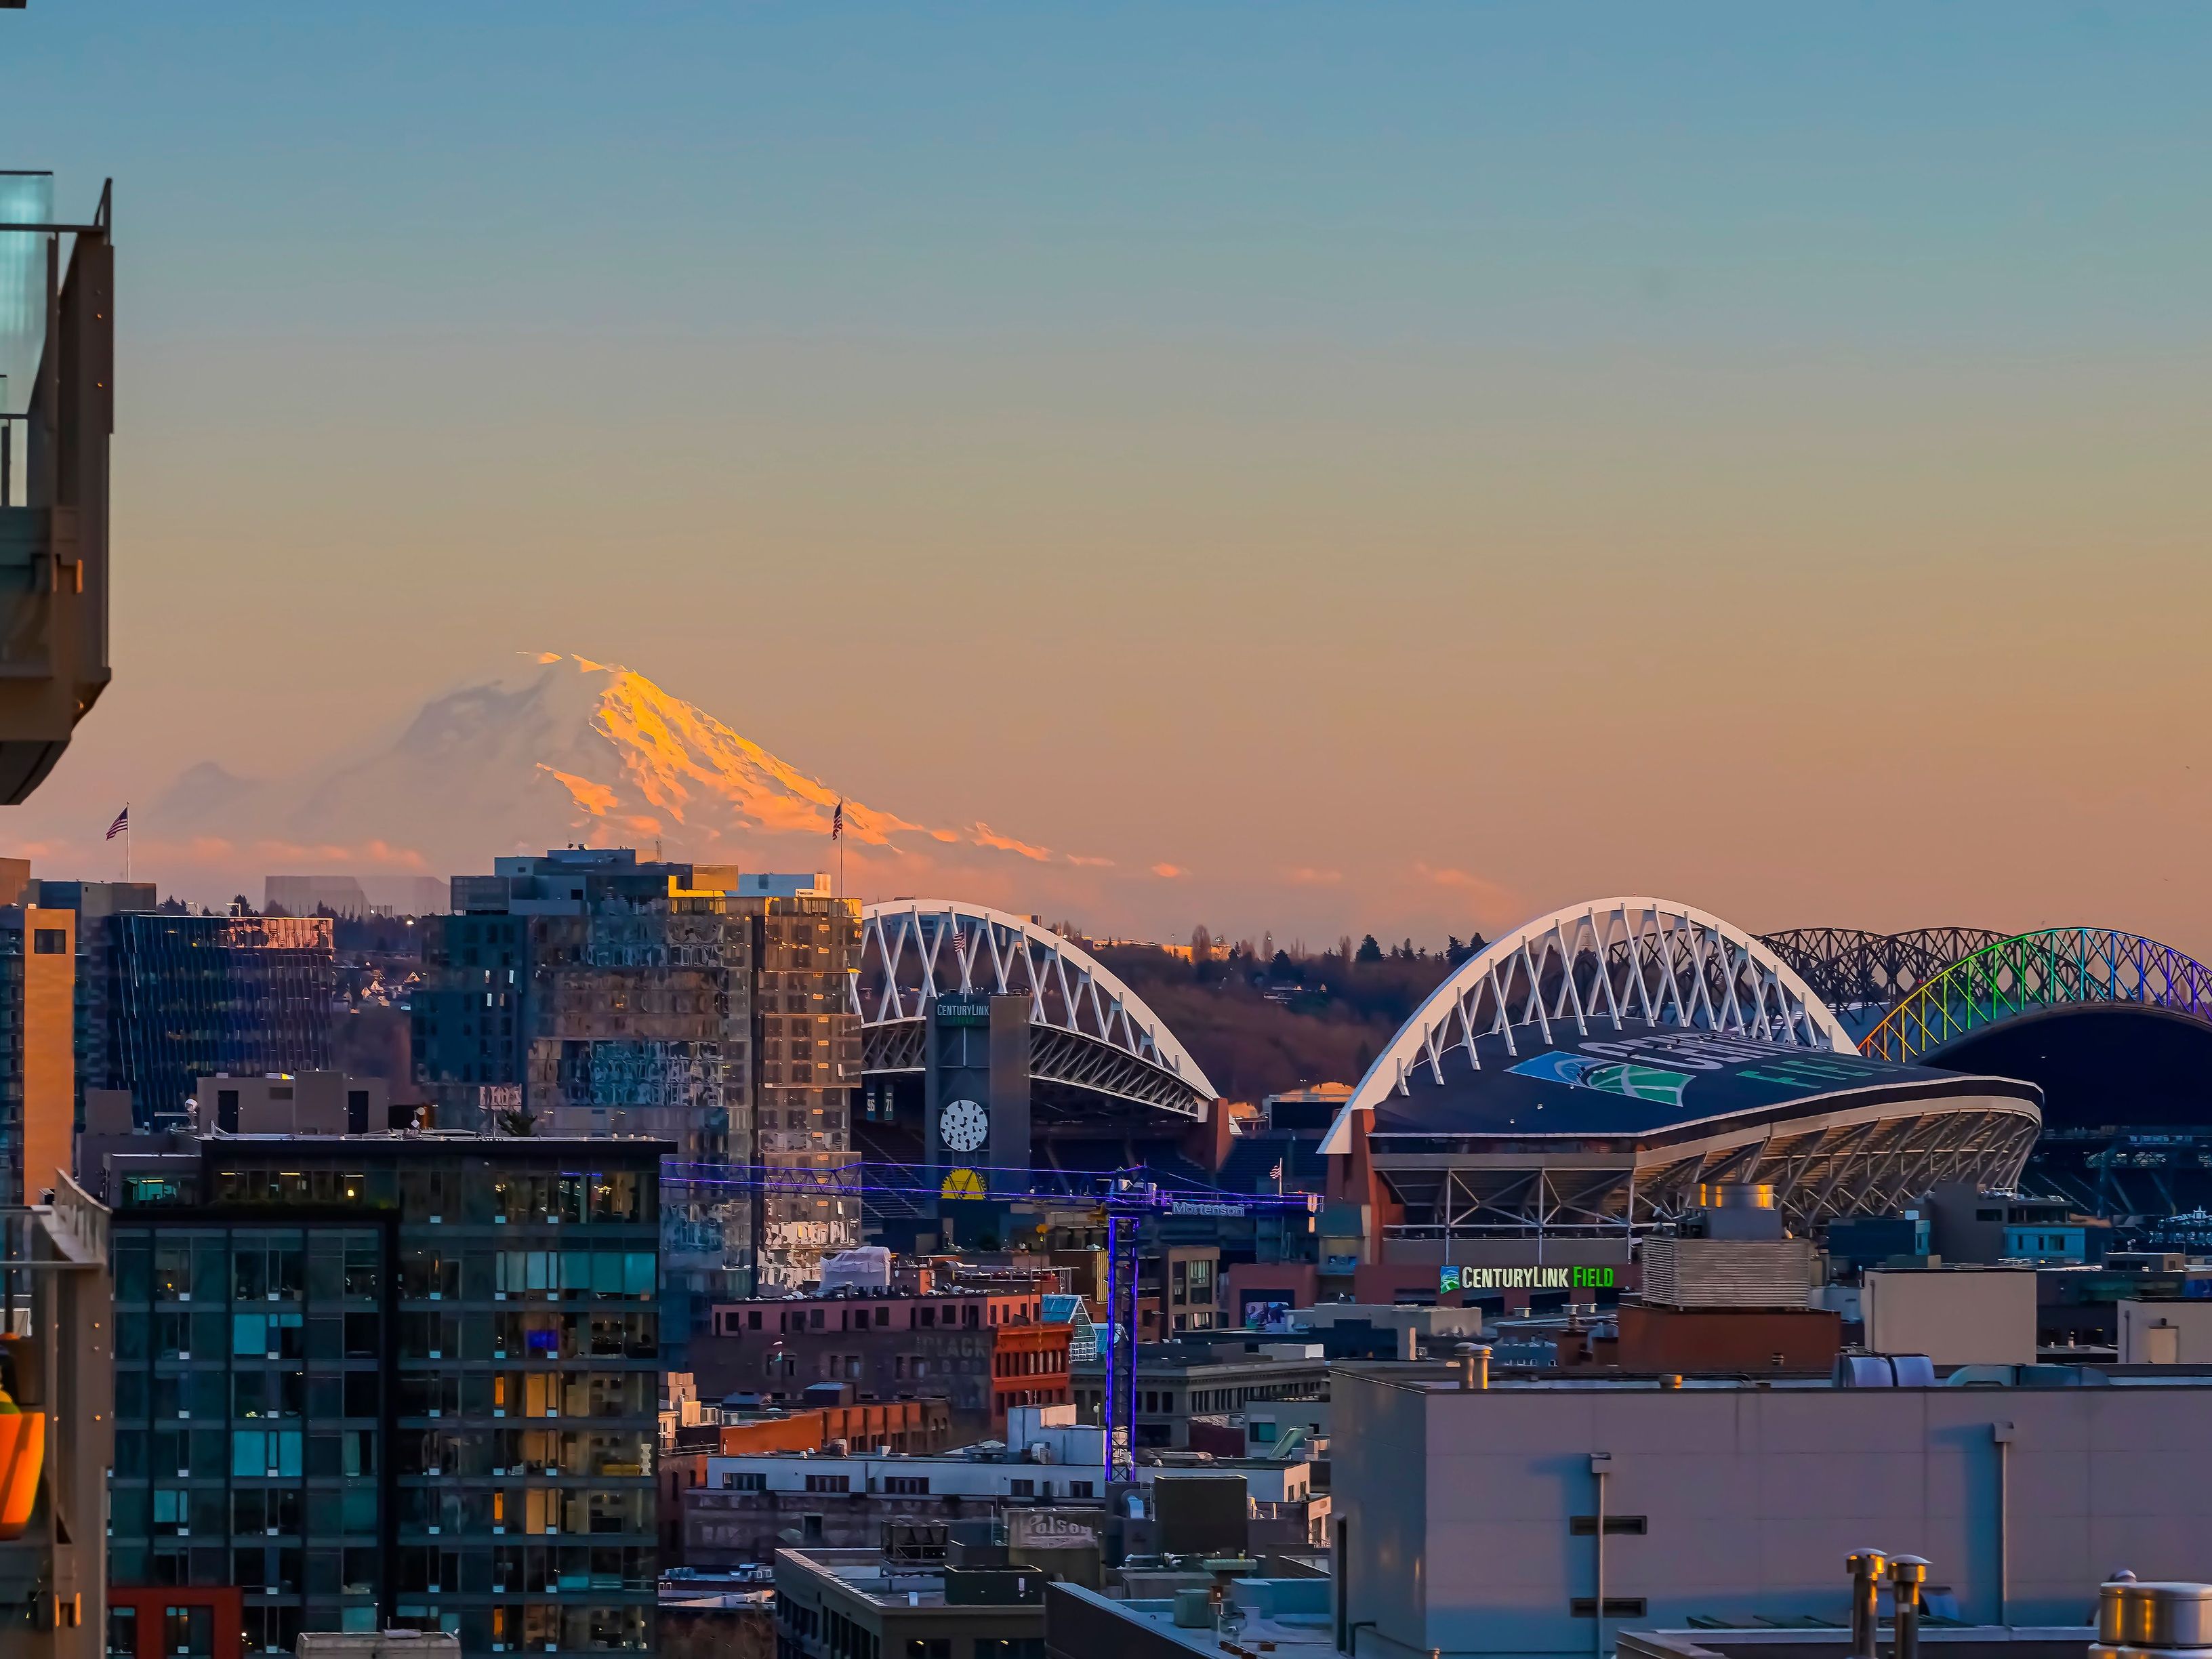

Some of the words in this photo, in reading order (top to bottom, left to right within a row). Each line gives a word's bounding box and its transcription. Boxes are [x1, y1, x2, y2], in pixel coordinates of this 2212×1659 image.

[937, 1004, 989, 1016] CENTURYLINK
[1172, 1202, 1244, 1217] Mortenson
[1462, 1266, 1569, 1288] CENTURYLINK
[1572, 1266, 1614, 1288] FIELD
